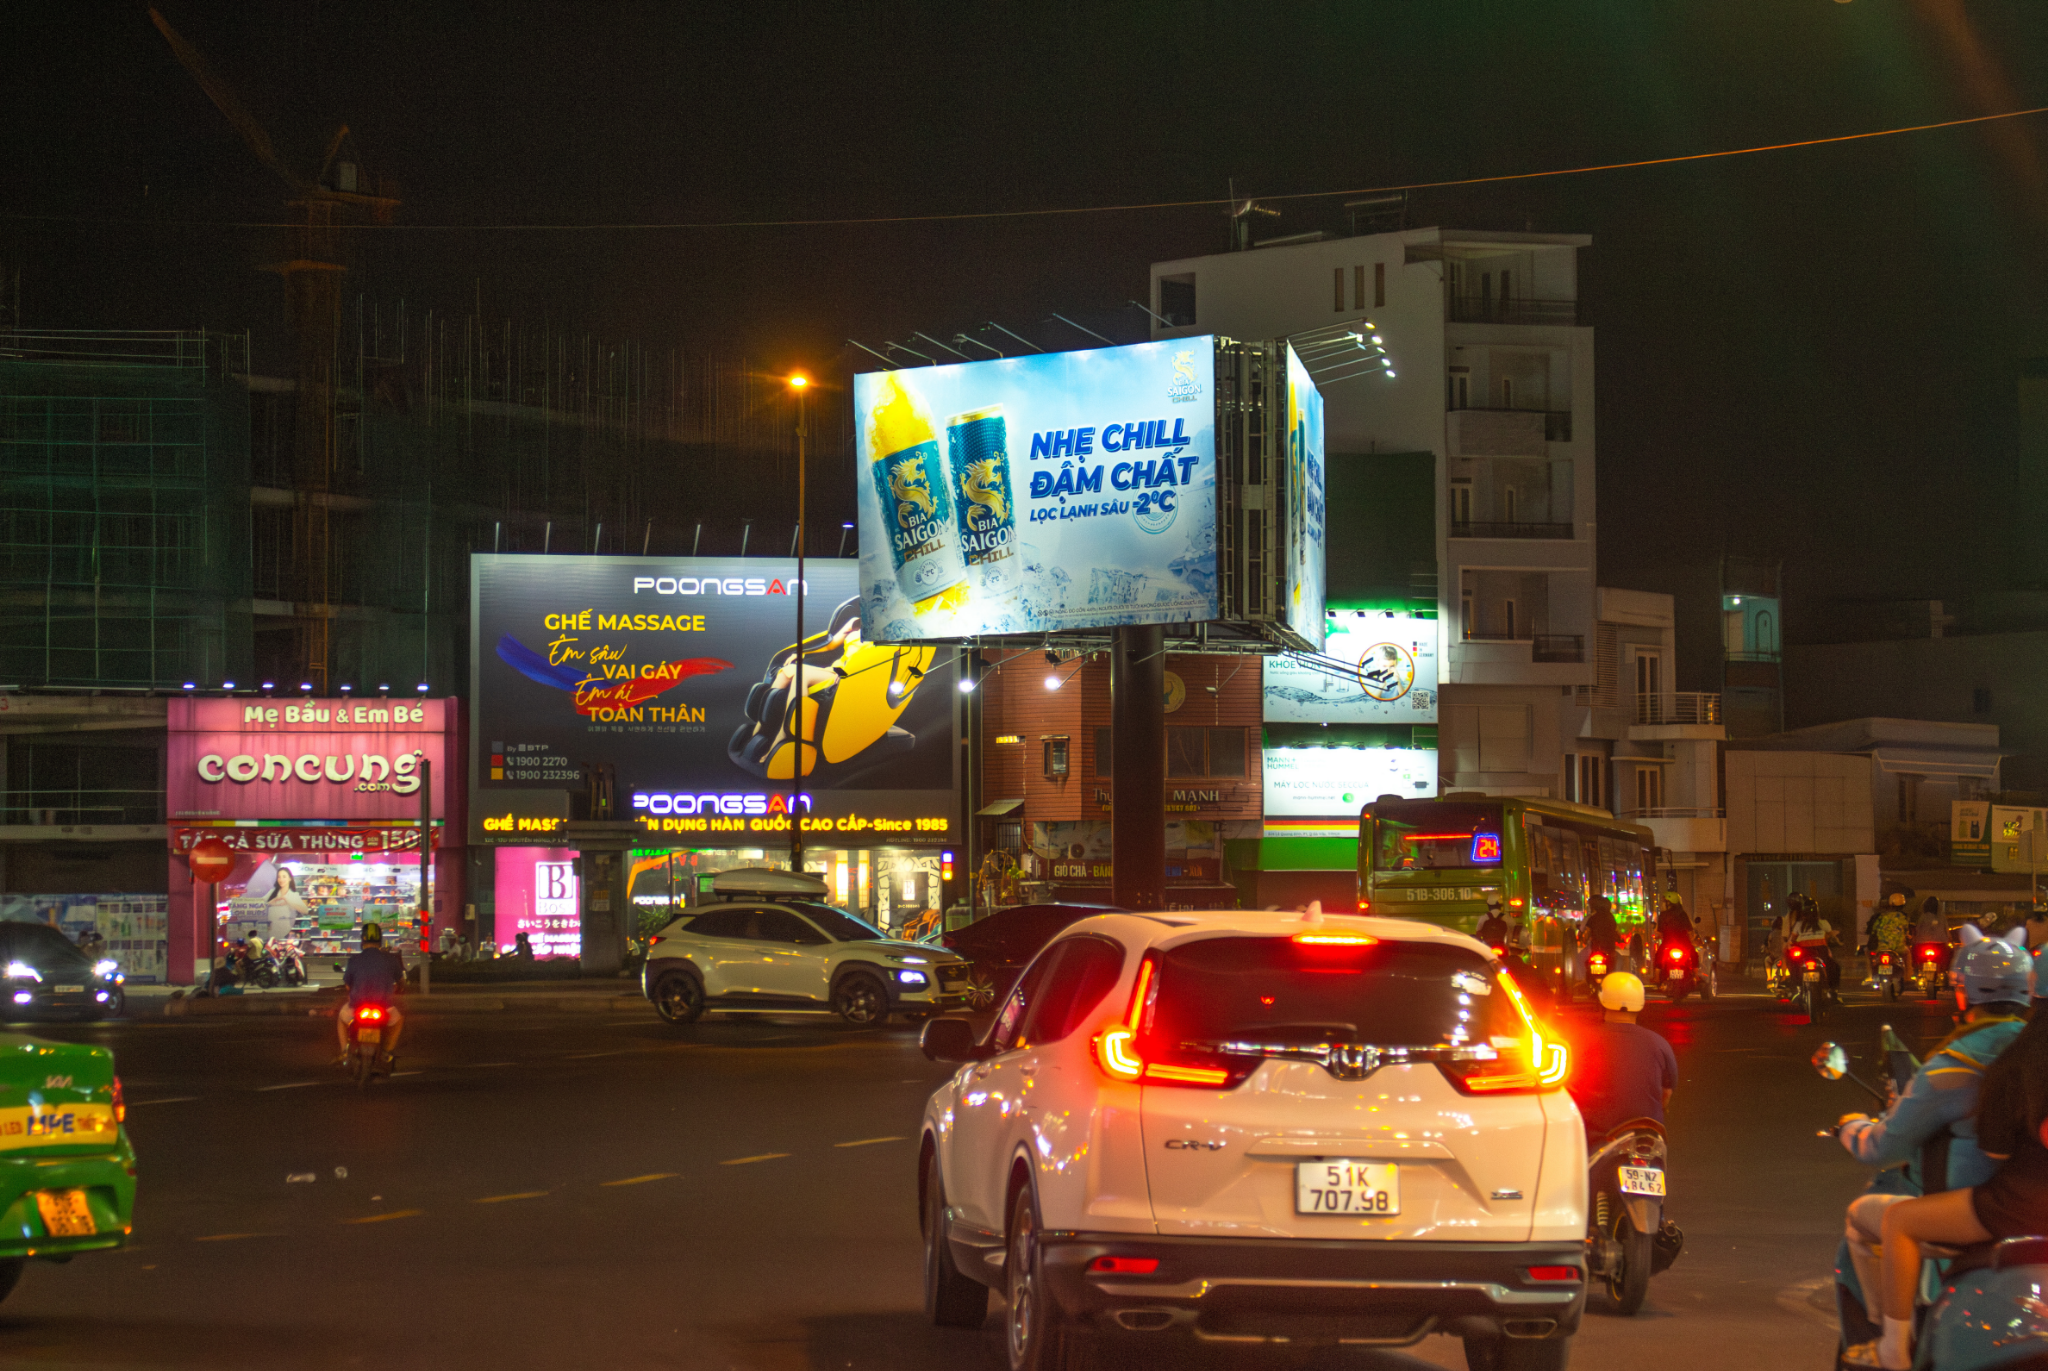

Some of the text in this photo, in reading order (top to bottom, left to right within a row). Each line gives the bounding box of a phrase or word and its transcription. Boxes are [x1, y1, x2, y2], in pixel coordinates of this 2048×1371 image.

[1167, 384, 1202, 397] SAIGON
[1030, 417, 1190, 463] NHẸ CHILL
[1030, 446, 1199, 504] ĐẬM CHẤT
[908, 512, 927, 528] BIA
[1029, 507, 1058, 524] LỌC
[1059, 504, 1098, 522] LẠNH
[1100, 498, 1130, 515] SÂU
[894, 516, 949, 551] SAIGON
[977, 517, 998, 532] BIA
[961, 525, 1017, 552] SAIGON
[903, 538, 945, 563] CHILL
[969, 547, 1014, 566] CHILL
[633, 577, 808, 596] POONGSAN
[544, 608, 706, 631] GHẾ MASSAGE
[548, 633, 627, 666] Êm sâu
[602, 660, 682, 680] VAI GÁY
[1269, 658, 1296, 669] KHỎE
[575, 673, 612, 706] Êm
[244, 700, 424, 728] Mẹ Bầu & Em Bé
[587, 702, 706, 722] TOÀN THÂN
[516, 757, 568, 766] 1900 2270
[516, 770, 580, 780] 1900 232396
[1173, 790, 1219, 805] MẠNH
[483, 813, 514, 831] GHẾ
[663, 818, 708, 834] DỤNG
[711, 816, 745, 831] HÀN
[800, 818, 833, 831] CAO
[915, 818, 948, 831] 1985
[256, 832, 293, 849] SỮA
[299, 831, 364, 849] THÙNG
[1480, 839, 1497, 857] 24
[1054, 862, 1068, 877] GIÒ
[1069, 862, 1087, 877] CHẢ
[1406, 888, 1472, 901] 51B-306.10
[1164, 1139, 1227, 1151] CR-V
[1327, 1166, 1370, 1187] 51K
[1626, 1169, 1657, 1182] 59-N2
[1310, 1189, 1389, 1211] 707.98
